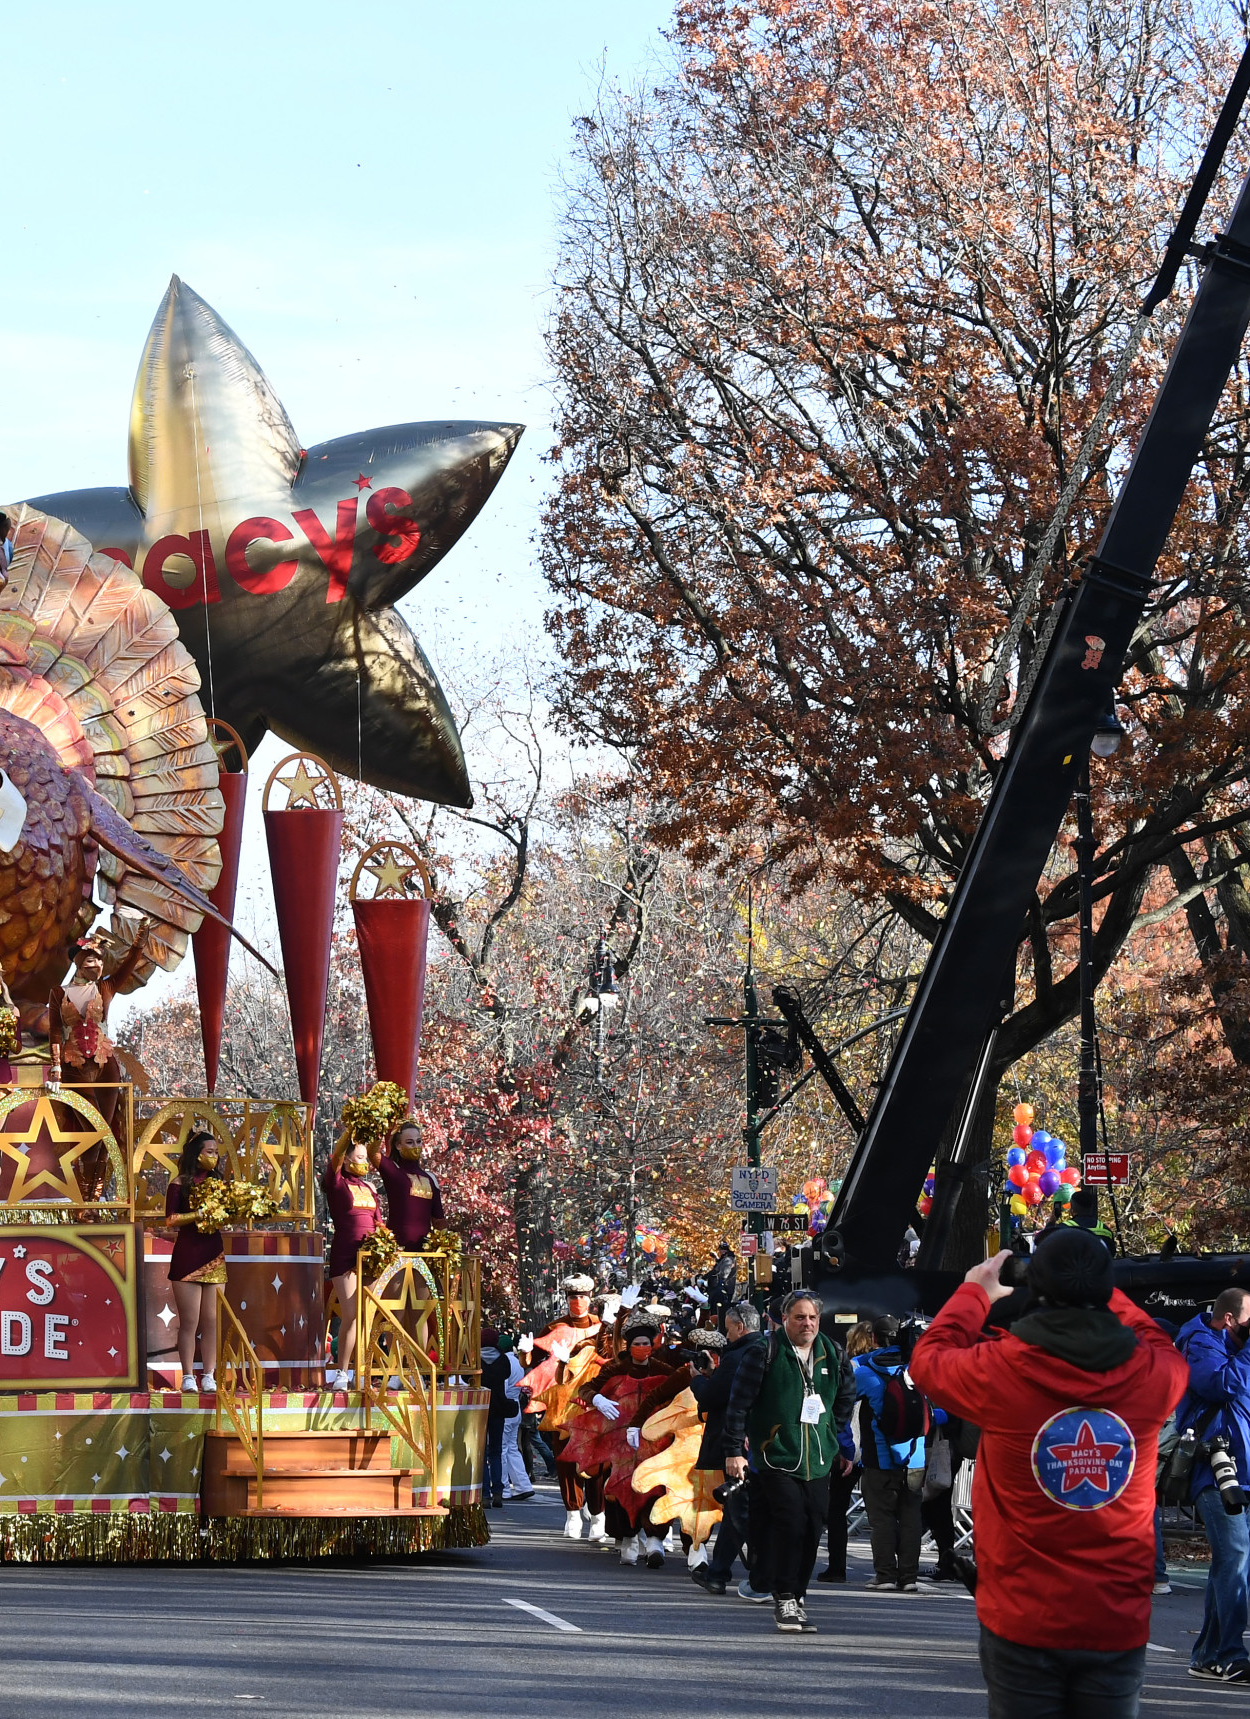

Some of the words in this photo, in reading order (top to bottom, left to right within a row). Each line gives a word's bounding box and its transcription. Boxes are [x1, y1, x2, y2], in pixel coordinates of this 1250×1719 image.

[99, 473, 420, 609] acy's
[739, 1170, 769, 1179] NYPD
[767, 1218, 775, 1229] W
[779, 1218, 790, 1229] 76
[794, 1217, 805, 1229] ST
[1071, 1448, 1101, 1457] MACY'S
[1047, 1459, 1106, 1470] THANKSGIVING
[1109, 1460, 1123, 1468] DAY
